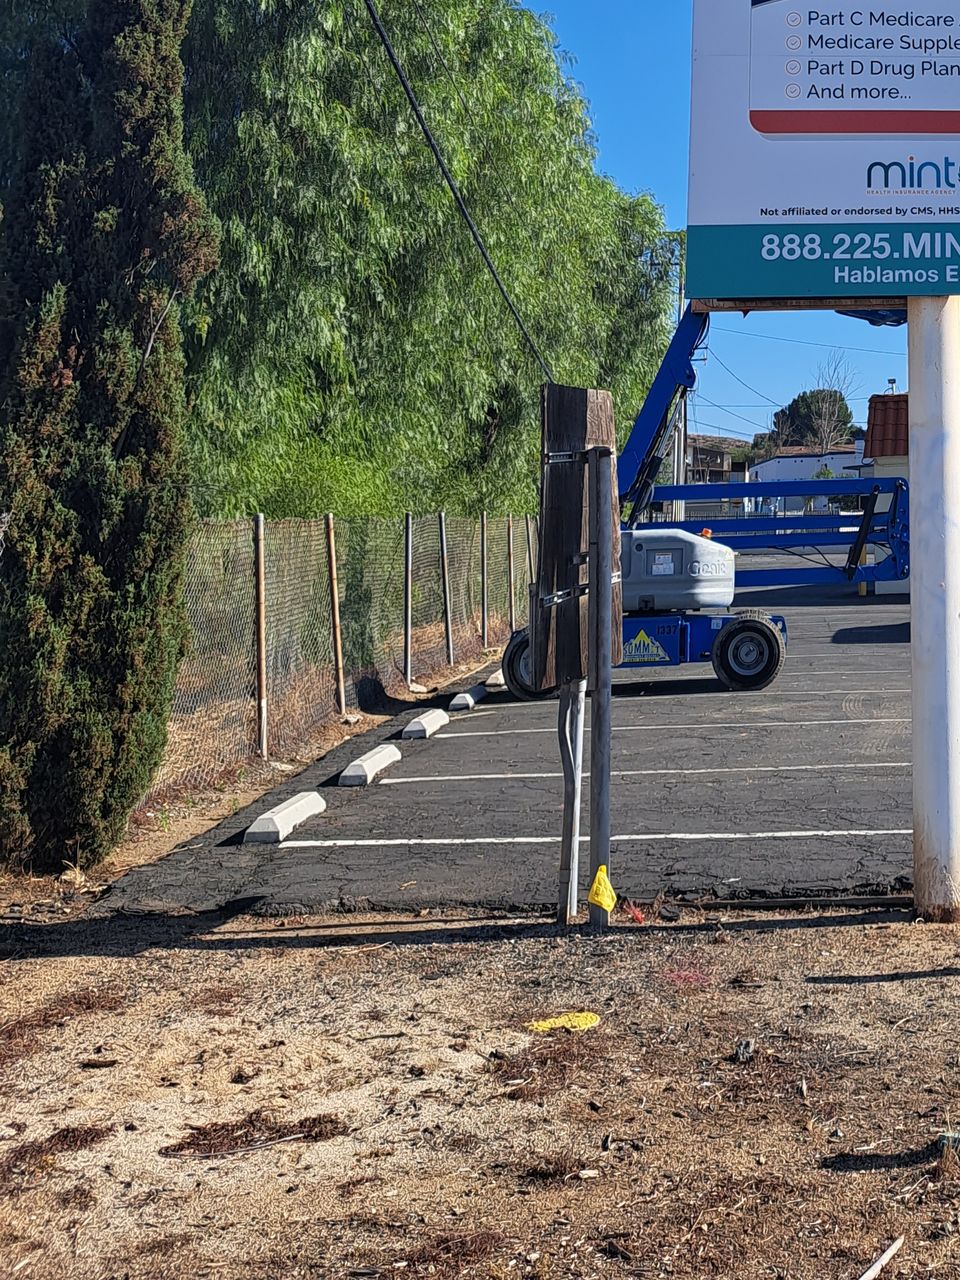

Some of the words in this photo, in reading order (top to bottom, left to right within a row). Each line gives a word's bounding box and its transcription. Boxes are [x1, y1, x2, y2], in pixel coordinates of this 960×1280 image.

[808, 10, 845, 27] Part
[849, 11, 864, 27] C
[869, 10, 954, 28] Medicare
[808, 33, 894, 51] Medicare
[807, 60, 845, 76] Part
[851, 60, 865, 76] D
[870, 60, 915, 80] Drug
[806, 83, 845, 100] And
[851, 86, 912, 100] more...
[867, 155, 956, 188] mint
[760, 207, 779, 216] Not
[781, 206, 828, 216] affiliated
[830, 208, 842, 216] or
[844, 207, 893, 216] endorsed
[895, 207, 908, 218] by
[910, 206, 937, 218] CMS,
[938, 206, 960, 216] HHS
[834, 265, 939, 284] Hablamos
[656, 624, 678, 635] 1337
